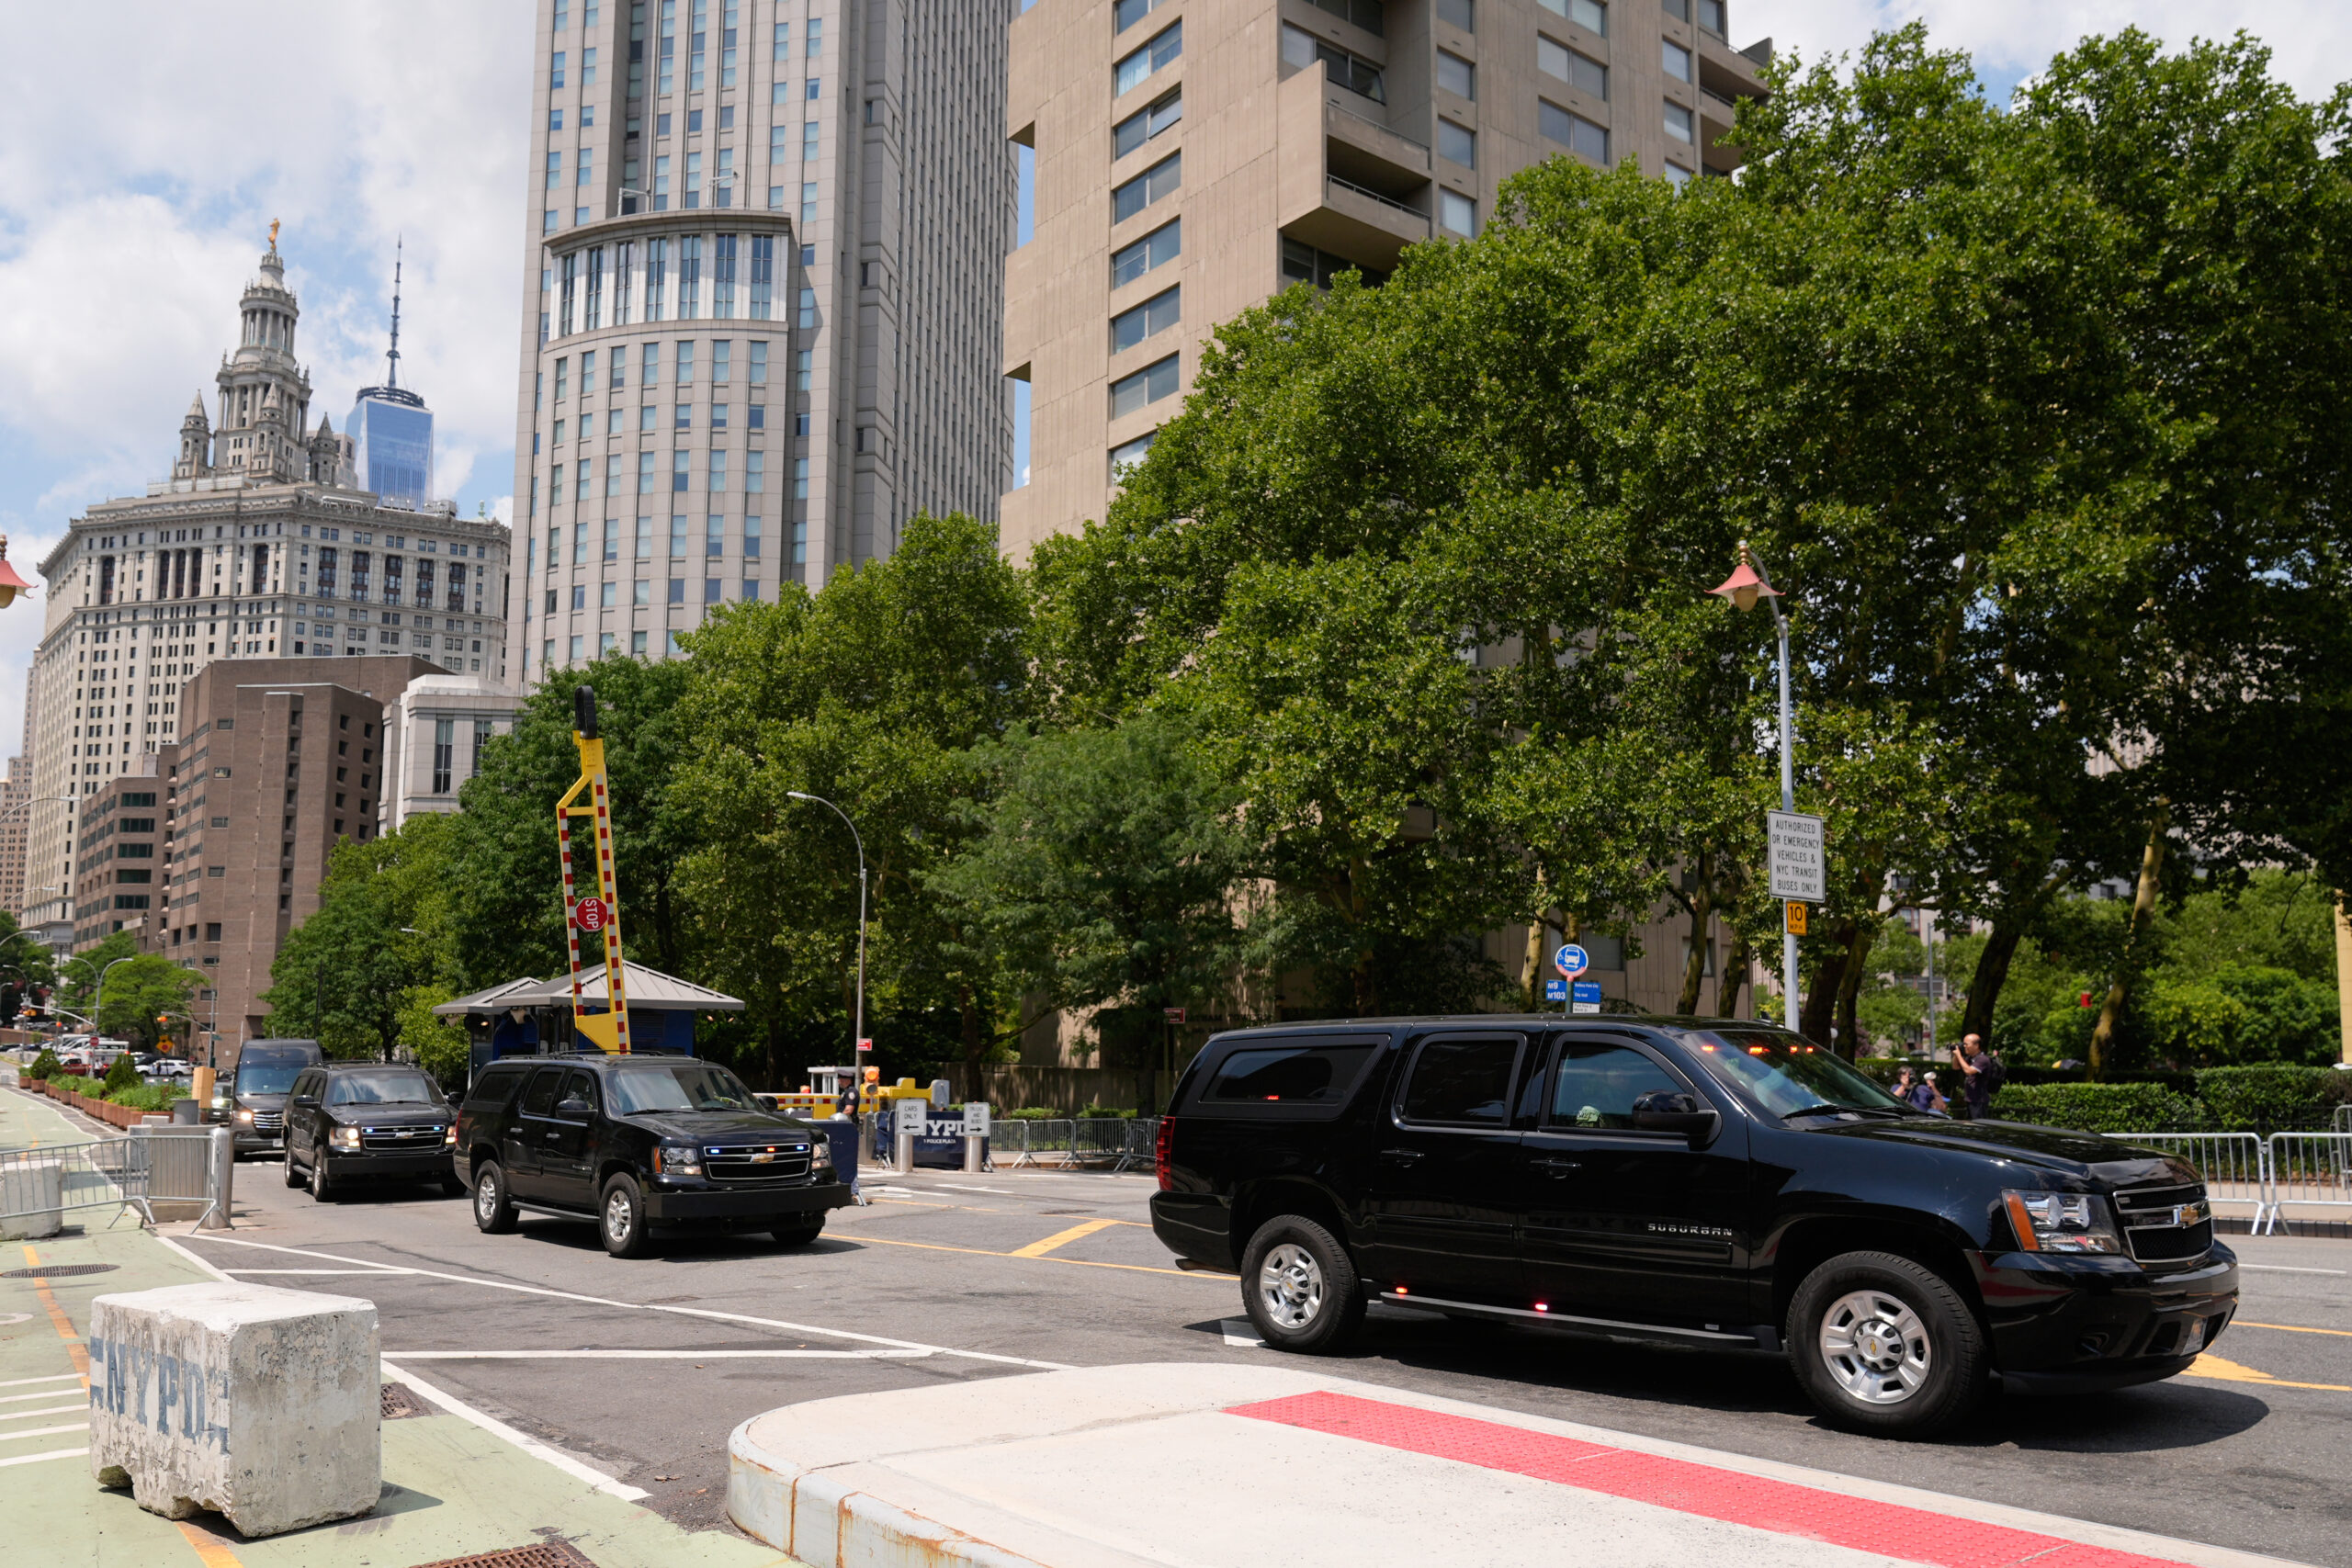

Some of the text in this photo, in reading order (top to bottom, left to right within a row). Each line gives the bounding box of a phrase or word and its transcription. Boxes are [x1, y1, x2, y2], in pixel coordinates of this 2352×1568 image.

[1775, 819, 1815, 834] AUTHORIZED
[1771, 834, 1820, 850] OR EMERGENCY
[1777, 850, 1815, 863] VEHICLES &
[1776, 864, 1817, 879] NYC TRANSIT
[1777, 879, 1817, 894] BUSES ONLY
[585, 899, 599, 928] STOP
[1789, 906, 1804, 921] 10
[1647, 1223, 1733, 1236] SUBURBAN
